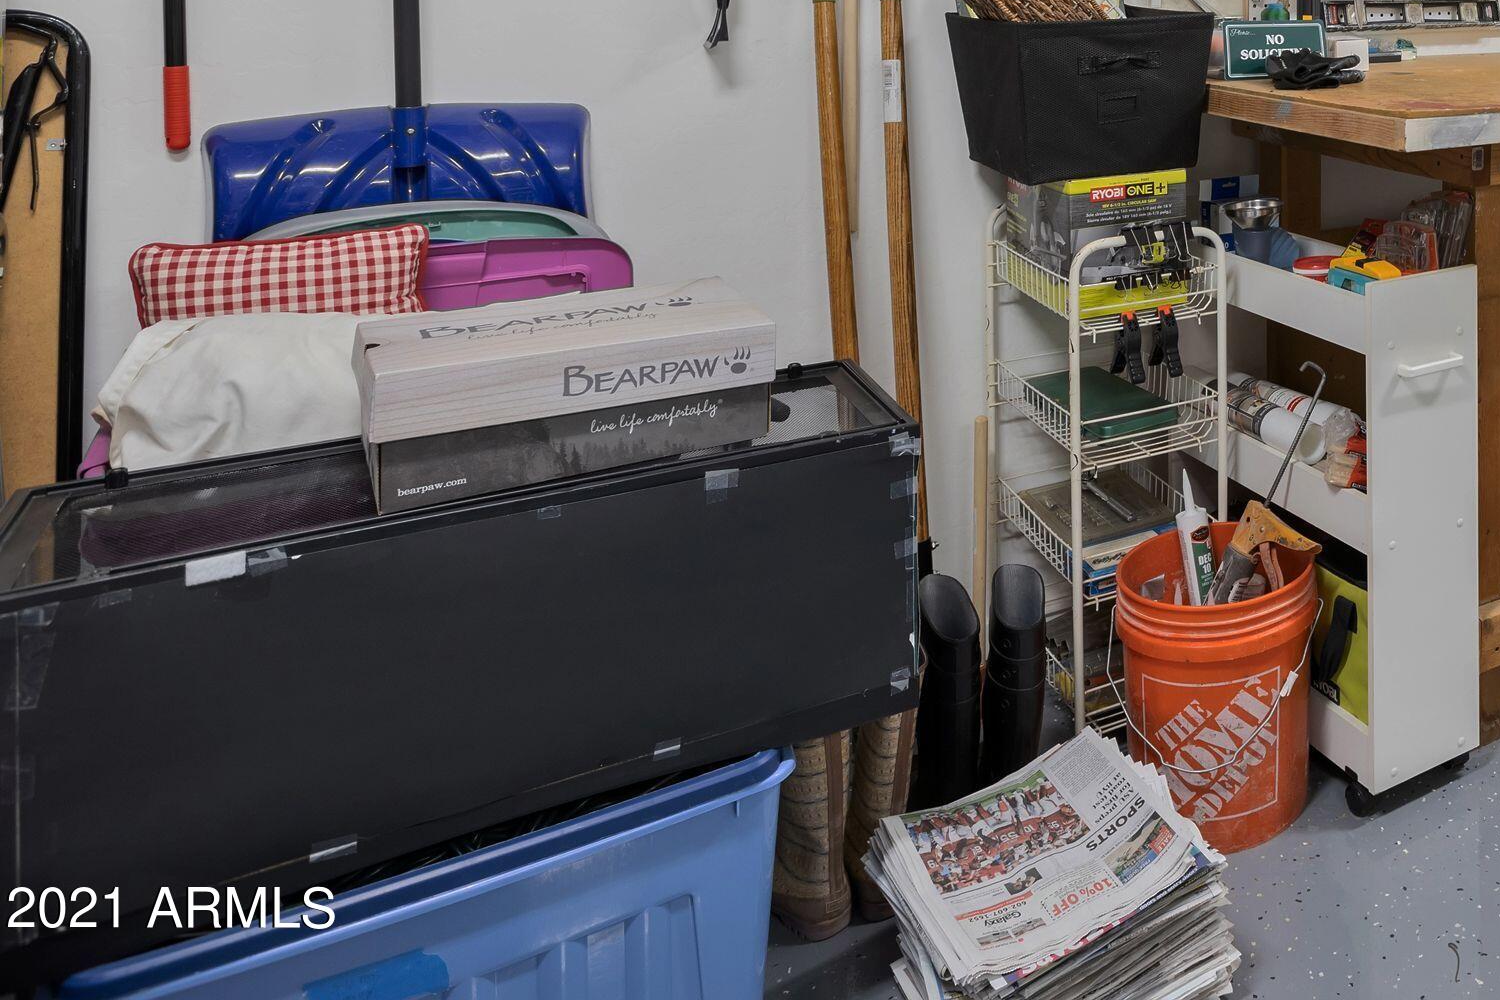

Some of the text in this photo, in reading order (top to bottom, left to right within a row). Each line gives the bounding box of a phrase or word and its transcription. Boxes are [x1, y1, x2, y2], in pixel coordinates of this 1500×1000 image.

[1265, 34, 1285, 45] NO
[1091, 186, 1124, 201] RYOBI
[418, 302, 648, 340] BEARPAW
[562, 354, 720, 397] BEARPAW
[590, 399, 718, 434] live life comfortably
[397, 475, 468, 498] bearpaw.com
[1154, 699, 1213, 751] THE
[1085, 796, 1146, 852] SPORTS
[1079, 877, 1113, 897] 10%
[1051, 893, 1080, 917] OFF
[984, 910, 1022, 927] Galaxy
